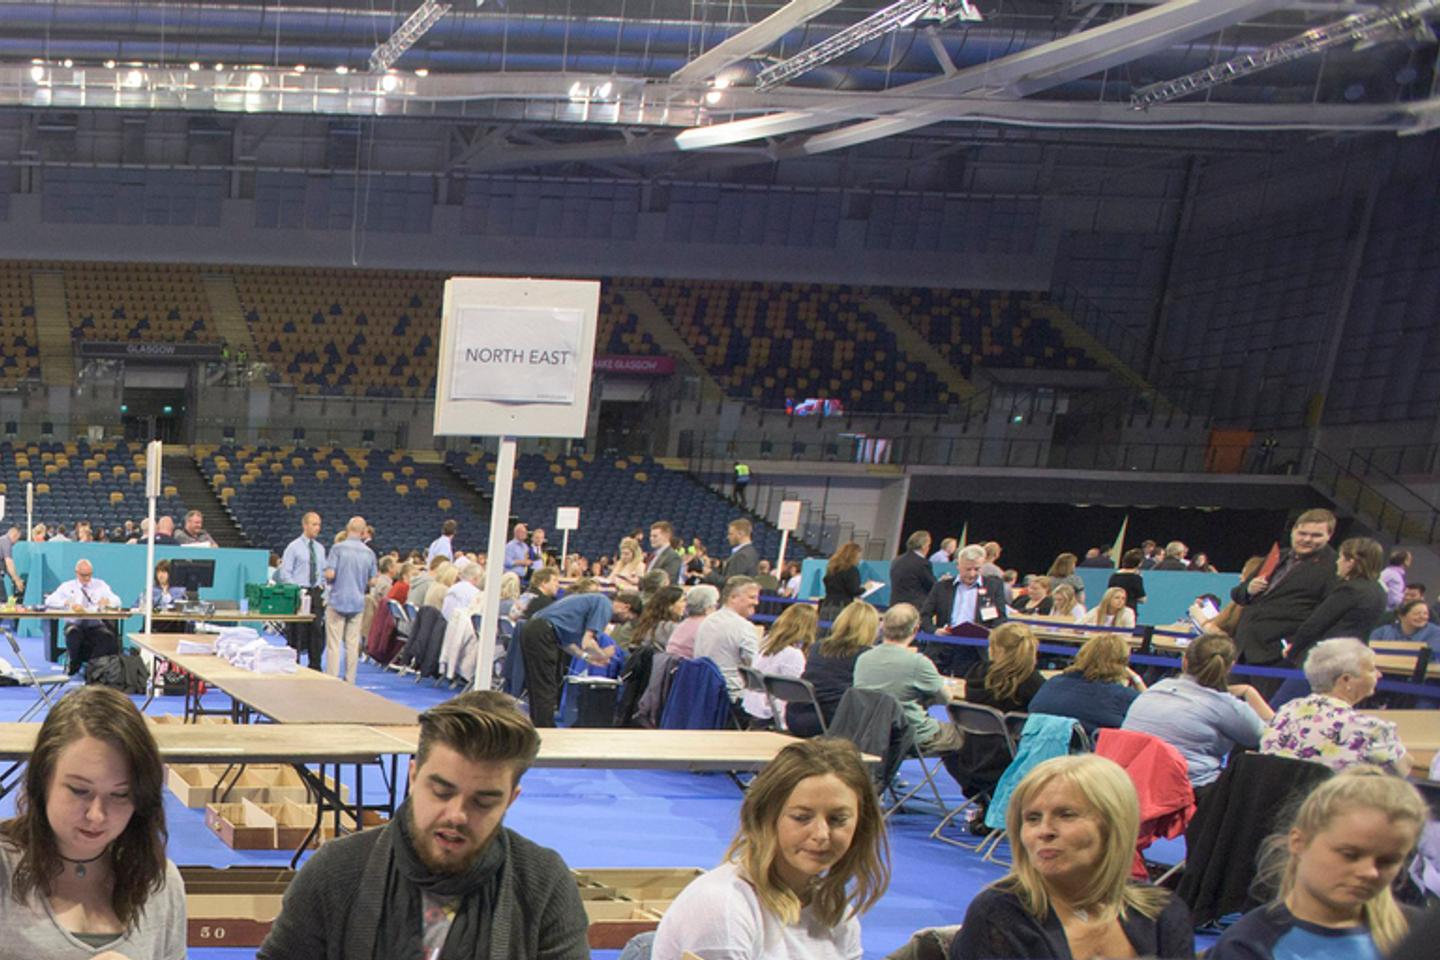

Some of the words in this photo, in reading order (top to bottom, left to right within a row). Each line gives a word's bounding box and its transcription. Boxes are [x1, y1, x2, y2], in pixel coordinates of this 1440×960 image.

[465, 347, 525, 363] NORTH
[529, 350, 571, 365] EAST
[200, 926, 225, 939] 50
